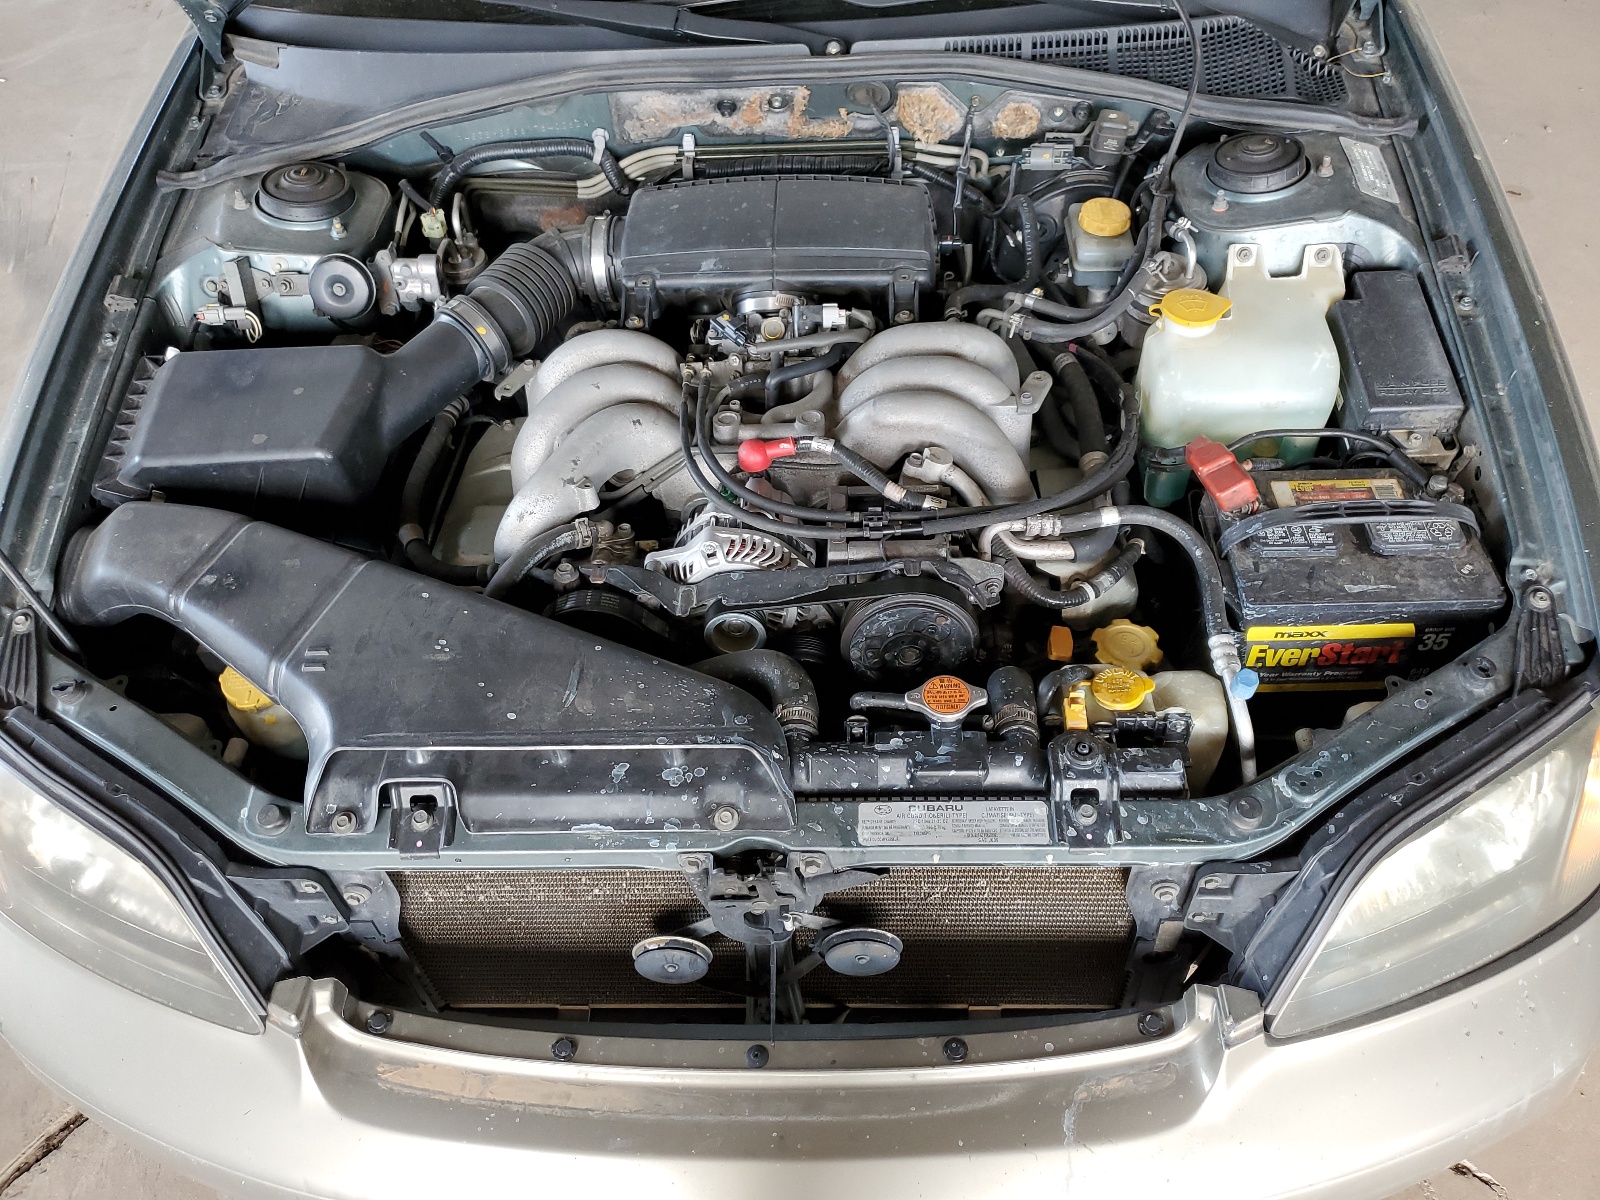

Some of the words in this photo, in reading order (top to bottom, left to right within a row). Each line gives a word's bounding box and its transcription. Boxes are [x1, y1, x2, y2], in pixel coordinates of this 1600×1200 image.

[1274, 631, 1328, 639] maxx
[1417, 633, 1452, 651] 35
[1245, 641, 1406, 668] EverStart
[1095, 668, 1140, 683] COOLANT
[908, 804, 964, 812] SUBARU
